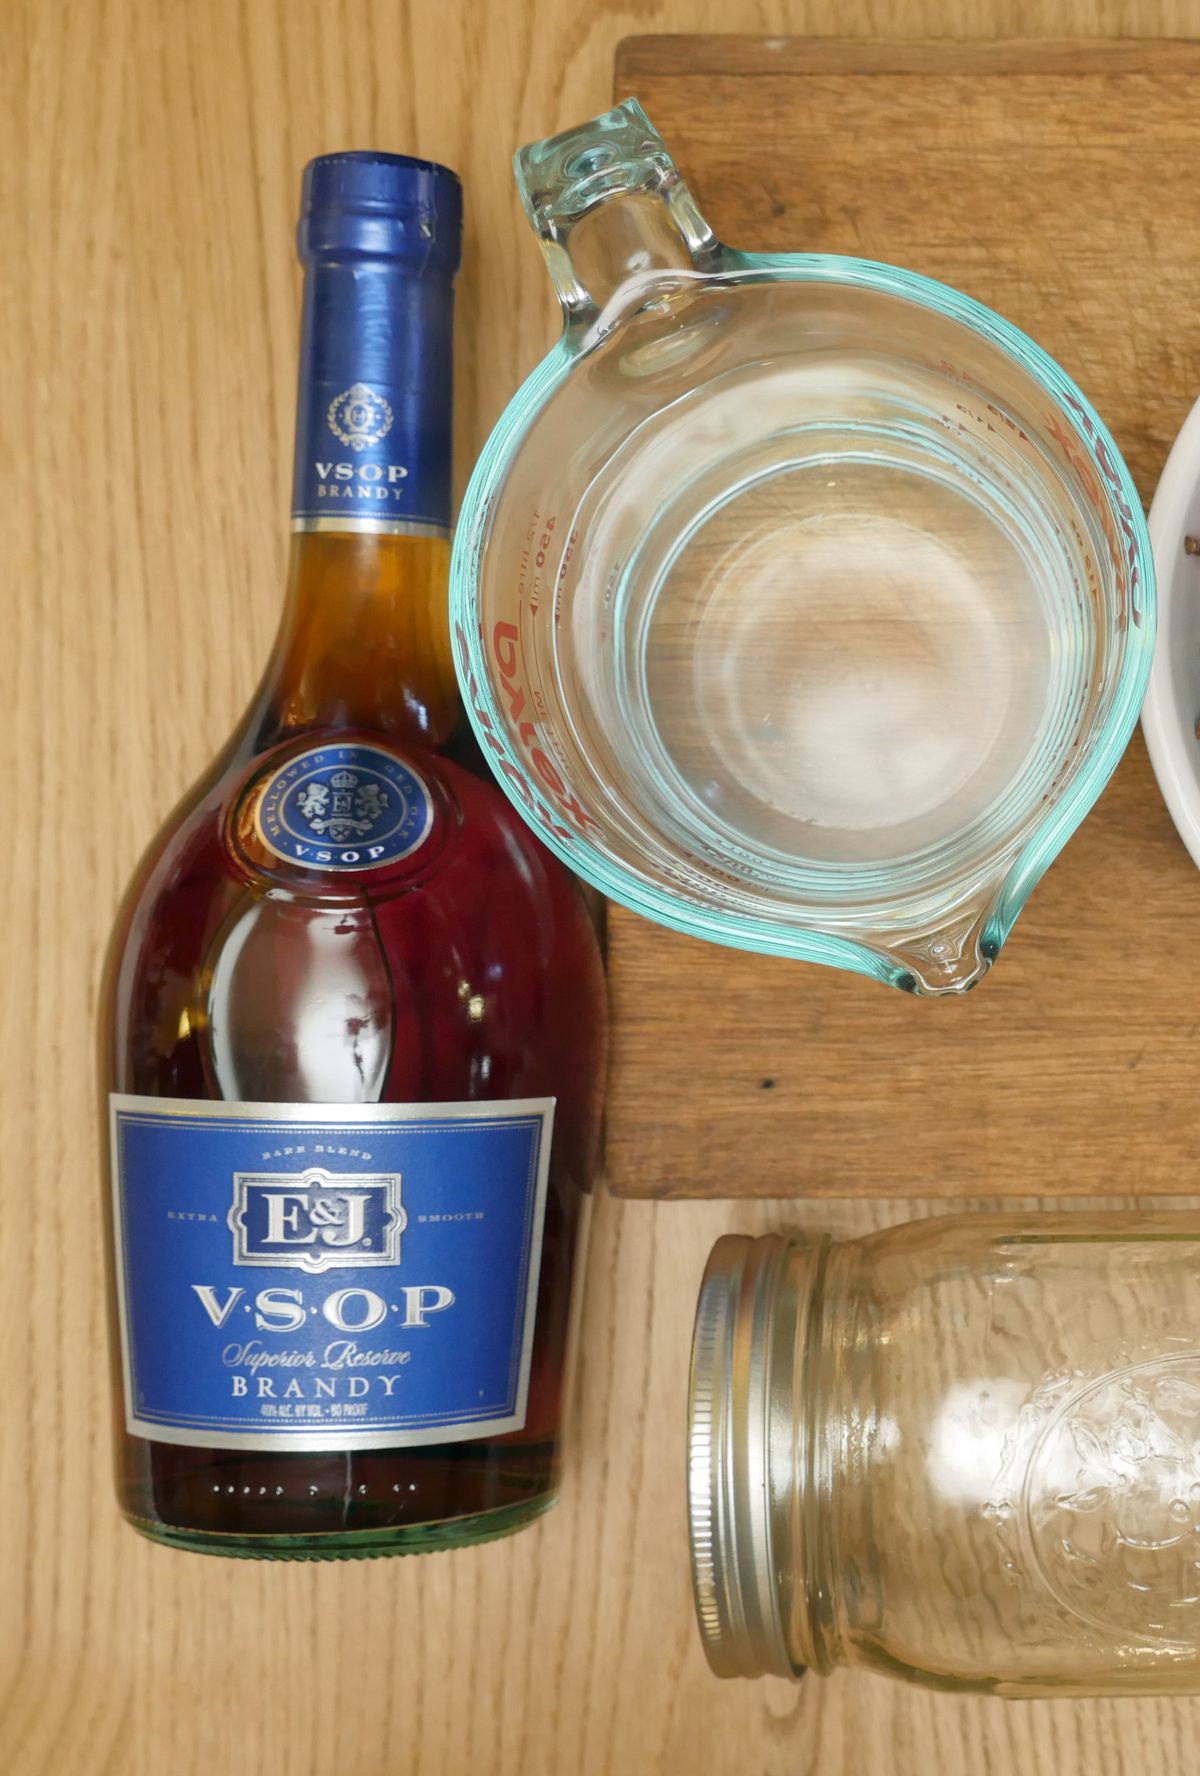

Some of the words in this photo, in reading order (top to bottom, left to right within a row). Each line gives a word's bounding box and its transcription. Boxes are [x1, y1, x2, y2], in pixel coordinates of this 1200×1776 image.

[318, 484, 403, 501] BRANDY
[266, 755, 325, 836] MELLOWED
[314, 1145, 372, 1160] BLEND
[168, 1211, 218, 1223] EXTRA
[418, 1211, 484, 1223] SMOOTH
[221, 1340, 317, 1376] Superior
[320, 1340, 412, 1370] Reserve
[231, 1375, 400, 1399] BRANDY
